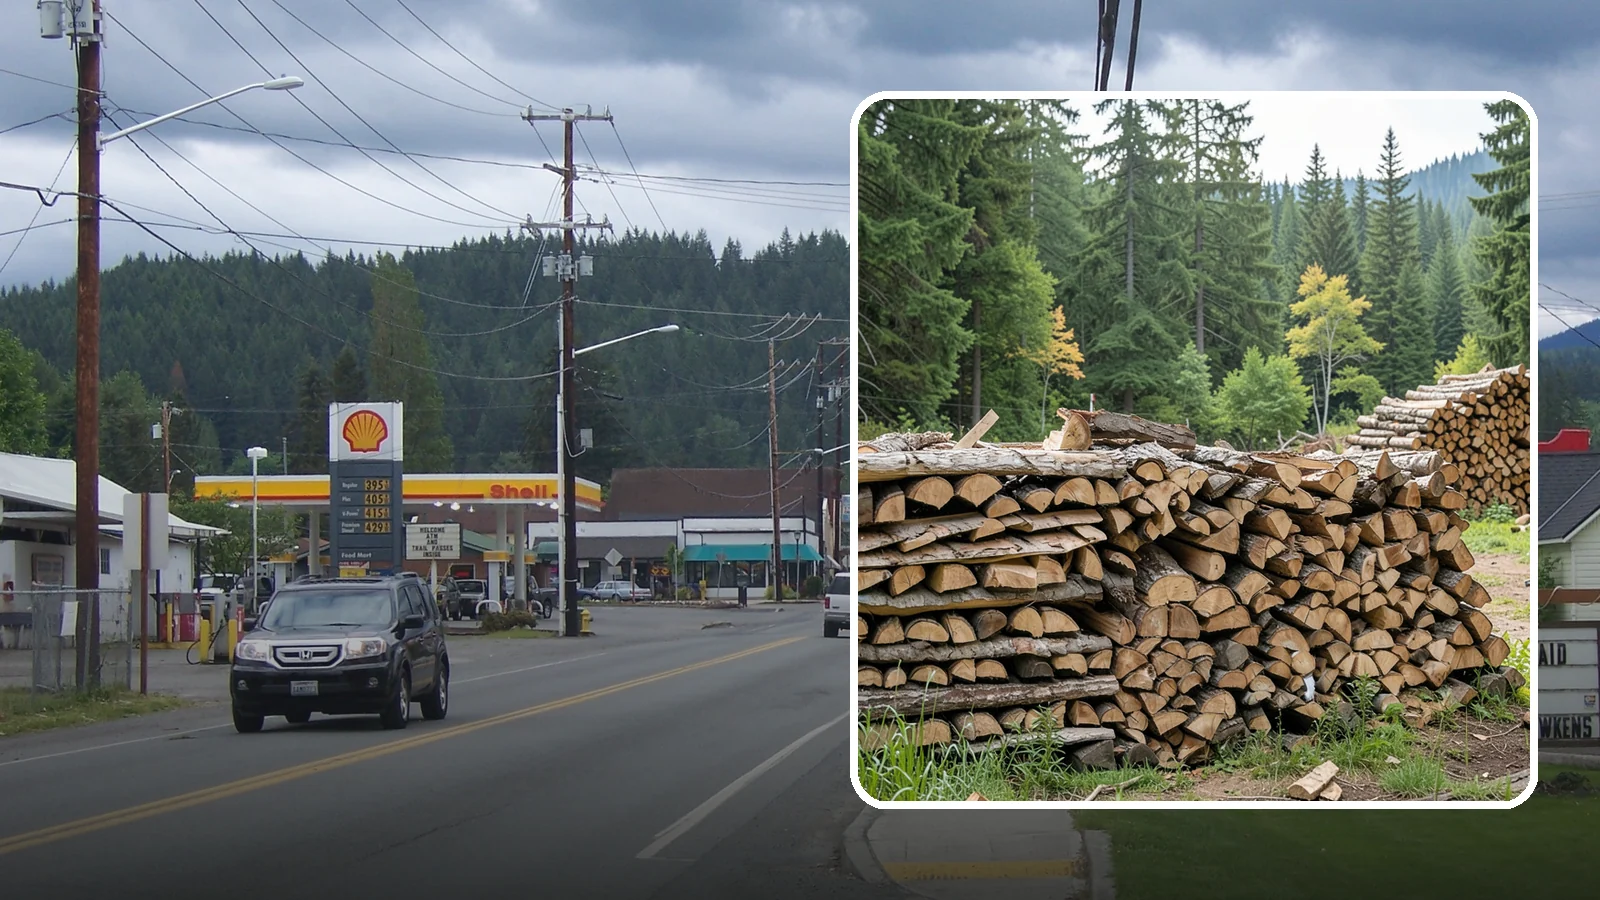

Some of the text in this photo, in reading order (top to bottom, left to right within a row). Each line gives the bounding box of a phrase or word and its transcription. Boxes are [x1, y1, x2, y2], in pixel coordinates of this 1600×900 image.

[366, 480, 383, 490] 395
[490, 484, 547, 499] Shell
[366, 494, 383, 504] 405
[366, 508, 383, 518] 415
[366, 522, 383, 532] 429
[1538, 642, 1566, 666] AID
[1538, 716, 1592, 738] WKENS
